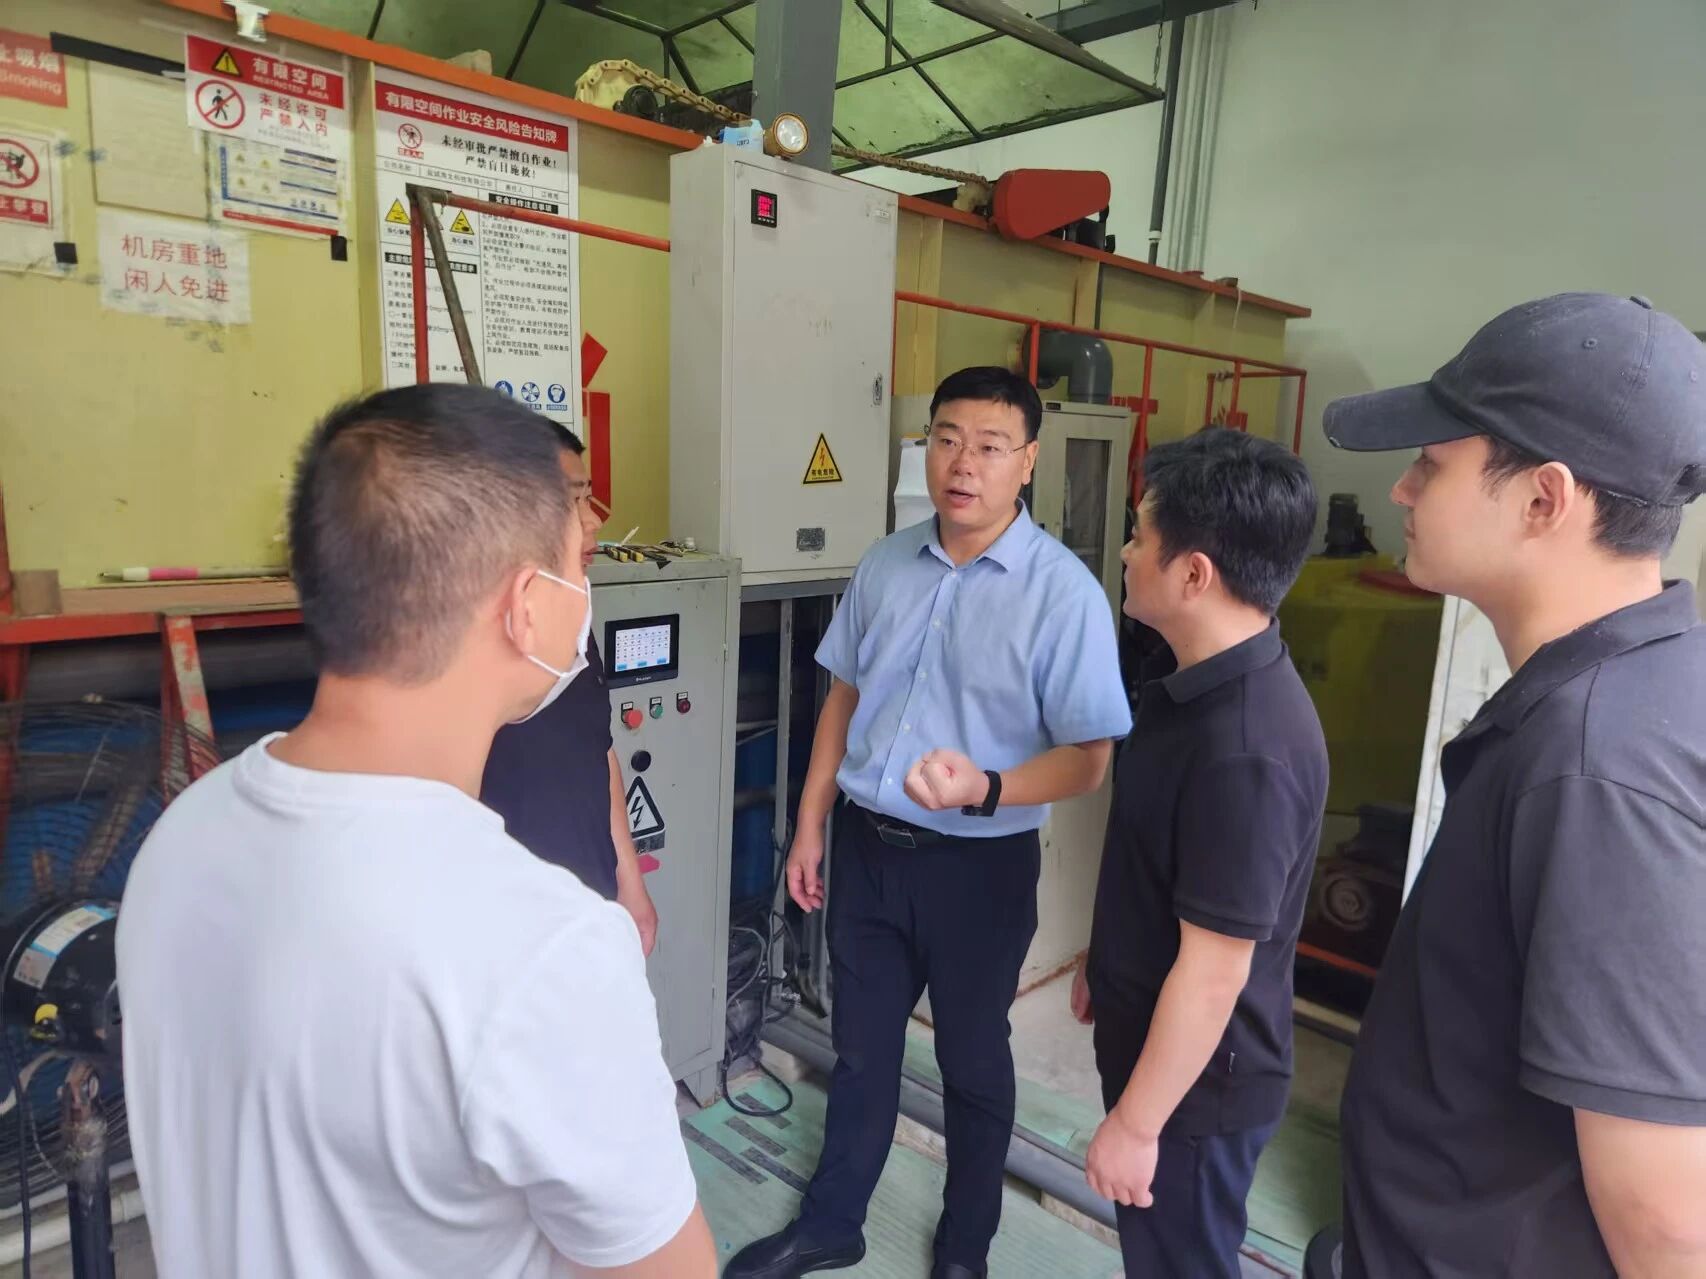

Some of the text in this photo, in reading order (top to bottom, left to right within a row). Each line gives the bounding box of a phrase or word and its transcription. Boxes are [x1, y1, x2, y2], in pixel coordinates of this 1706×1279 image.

[253, 57, 327, 89] 有限空间
[259, 93, 327, 120] 未经许可
[385, 91, 557, 144] 有限空间作业安全风险告知牌
[122, 234, 227, 269] 机房重地
[125, 268, 229, 303] 闲人免进
